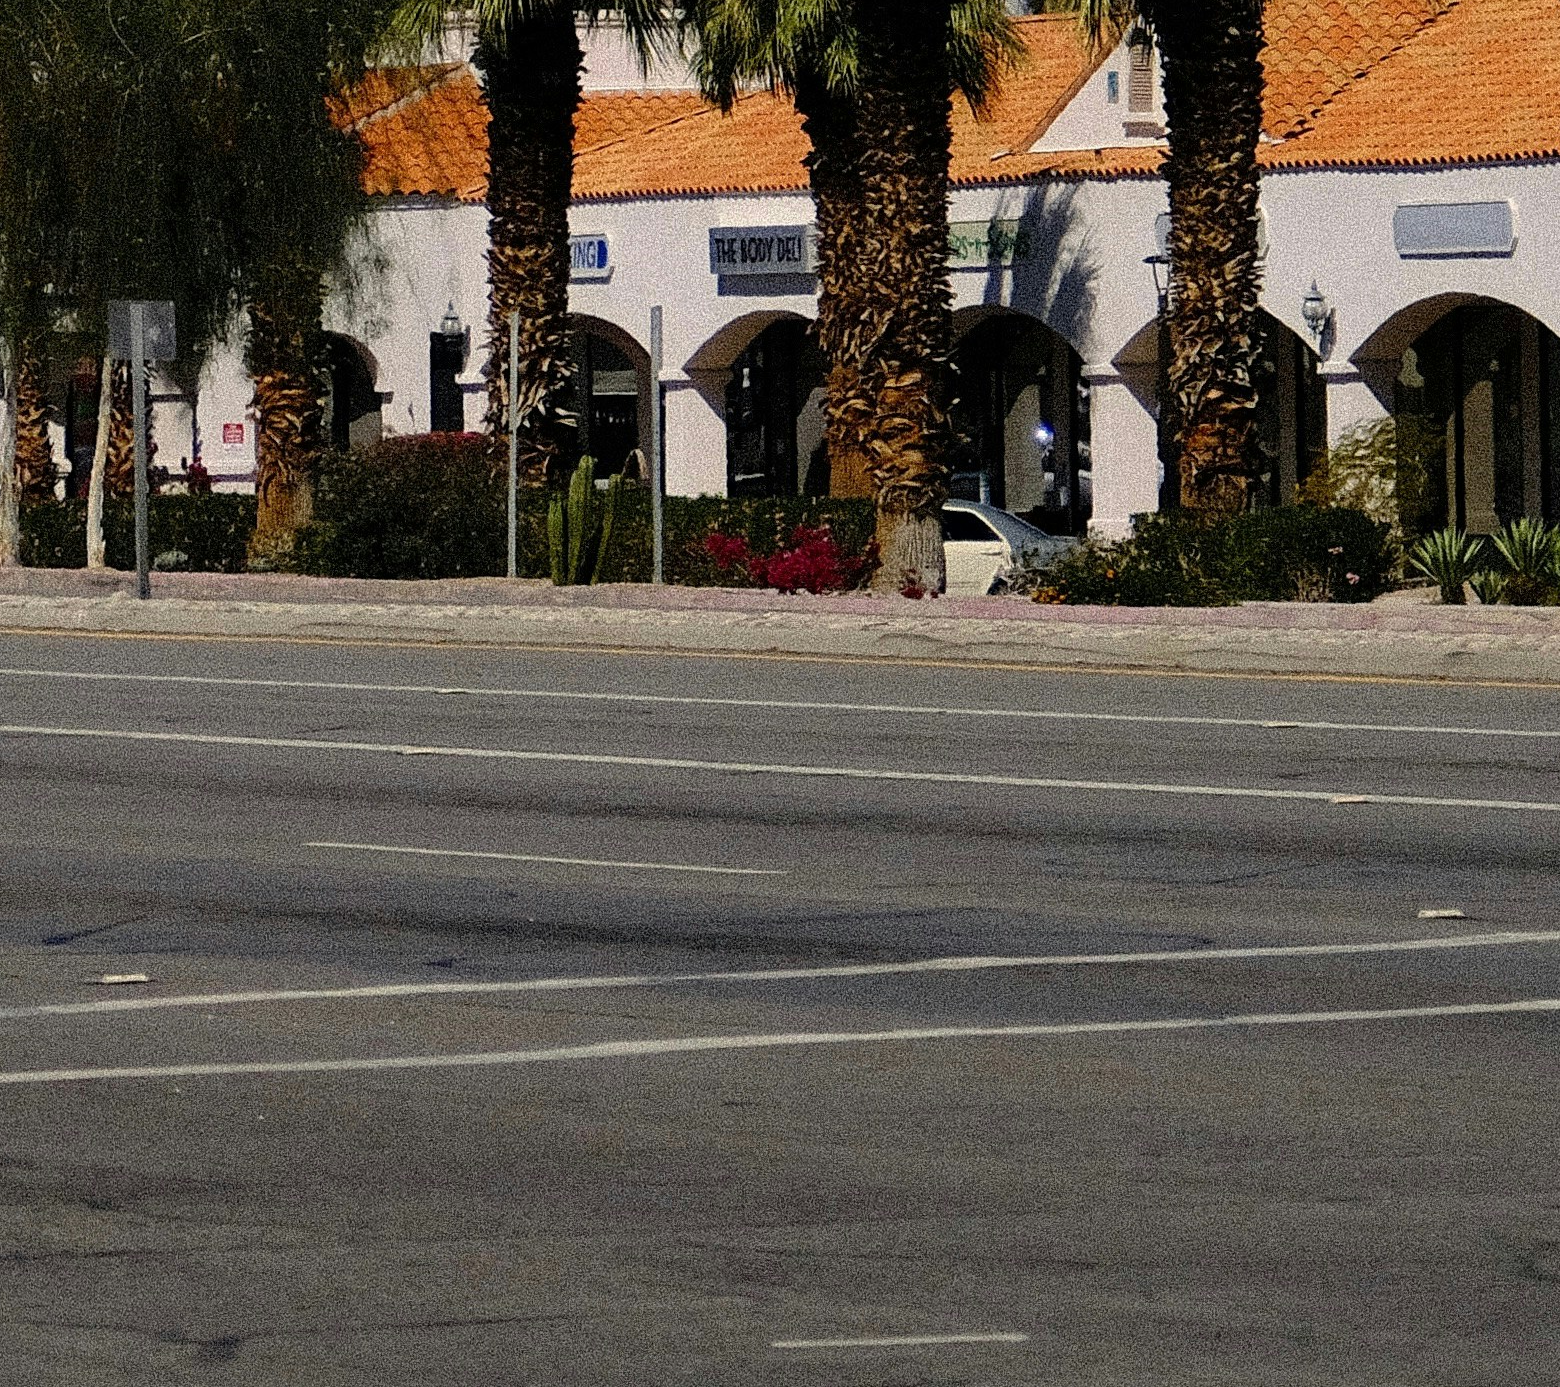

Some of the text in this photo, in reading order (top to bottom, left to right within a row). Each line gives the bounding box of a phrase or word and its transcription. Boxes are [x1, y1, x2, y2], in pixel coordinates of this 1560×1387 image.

[714, 235, 802, 264] THE BODY DELI
